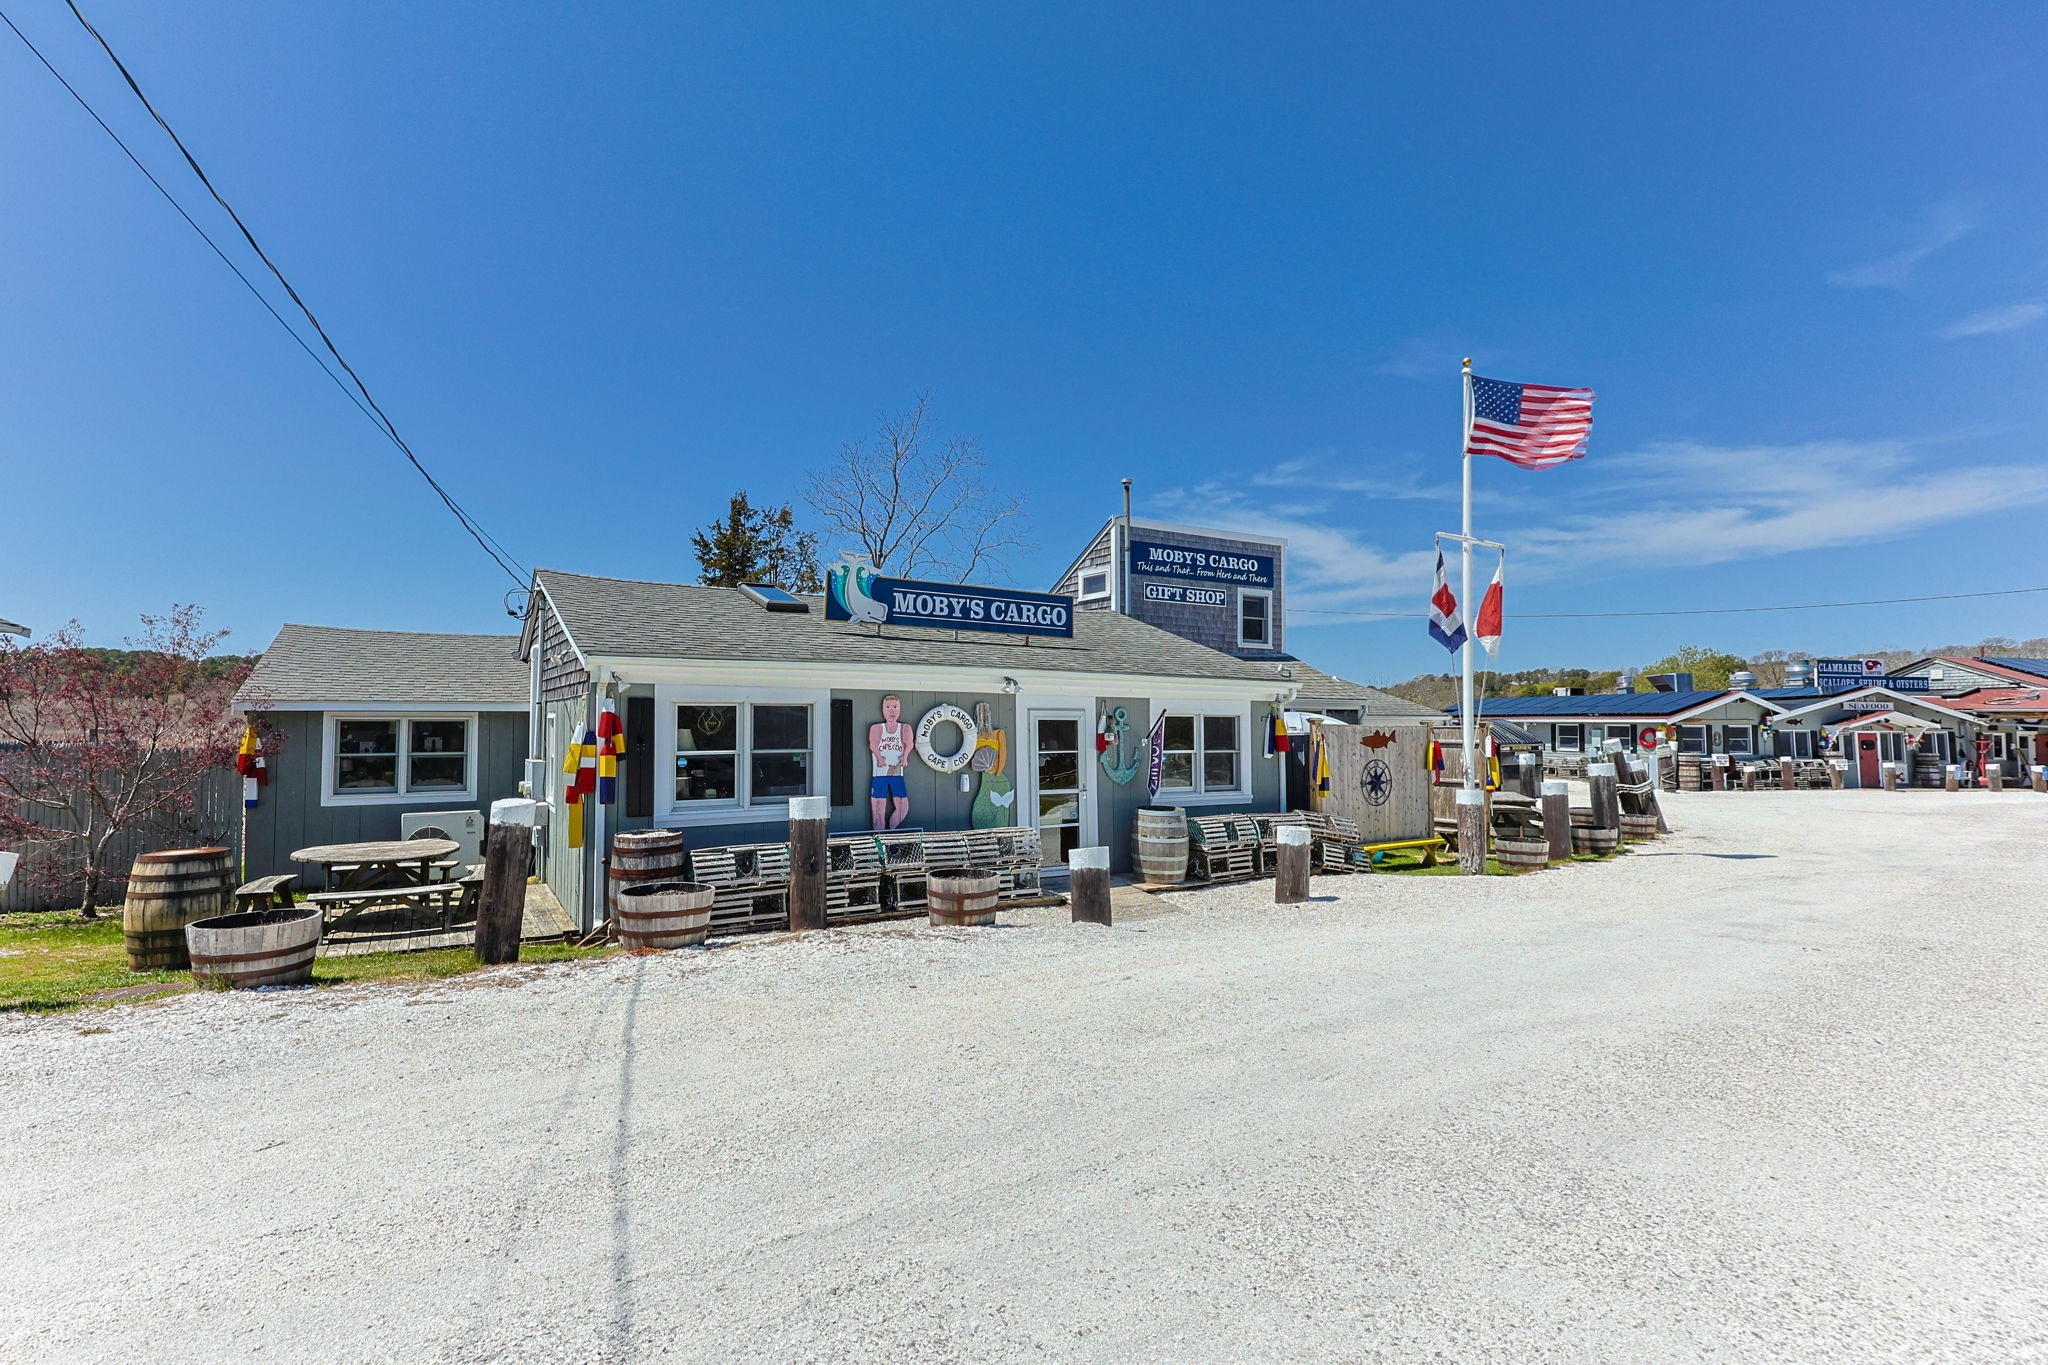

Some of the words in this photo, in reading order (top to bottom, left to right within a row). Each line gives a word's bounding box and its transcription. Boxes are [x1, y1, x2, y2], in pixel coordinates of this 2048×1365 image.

[1149, 547, 1206, 566] MOBY'S
[1209, 555, 1258, 571] CARGO
[1137, 561, 1153, 572] This
[1154, 562, 1171, 572] and
[1196, 567, 1215, 577] From
[1216, 570, 1232, 579] Here
[1233, 571, 1248, 581] and
[1248, 573, 1268, 584] There
[1146, 585, 1183, 600] GIFT
[1186, 589, 1225, 604] SHOP
[893, 592, 985, 619] MOBY'S
[990, 601, 1067, 626] CARGO
[1818, 663, 1862, 673] CLAMBAKES
[1888, 680, 1895, 689] &
[1896, 679, 1928, 689] OYSTERS
[921, 710, 943, 738] MOBY'S
[950, 709, 973, 730] CARGO
[927, 753, 947, 769] CAPE
[953, 752, 969, 767] COD
